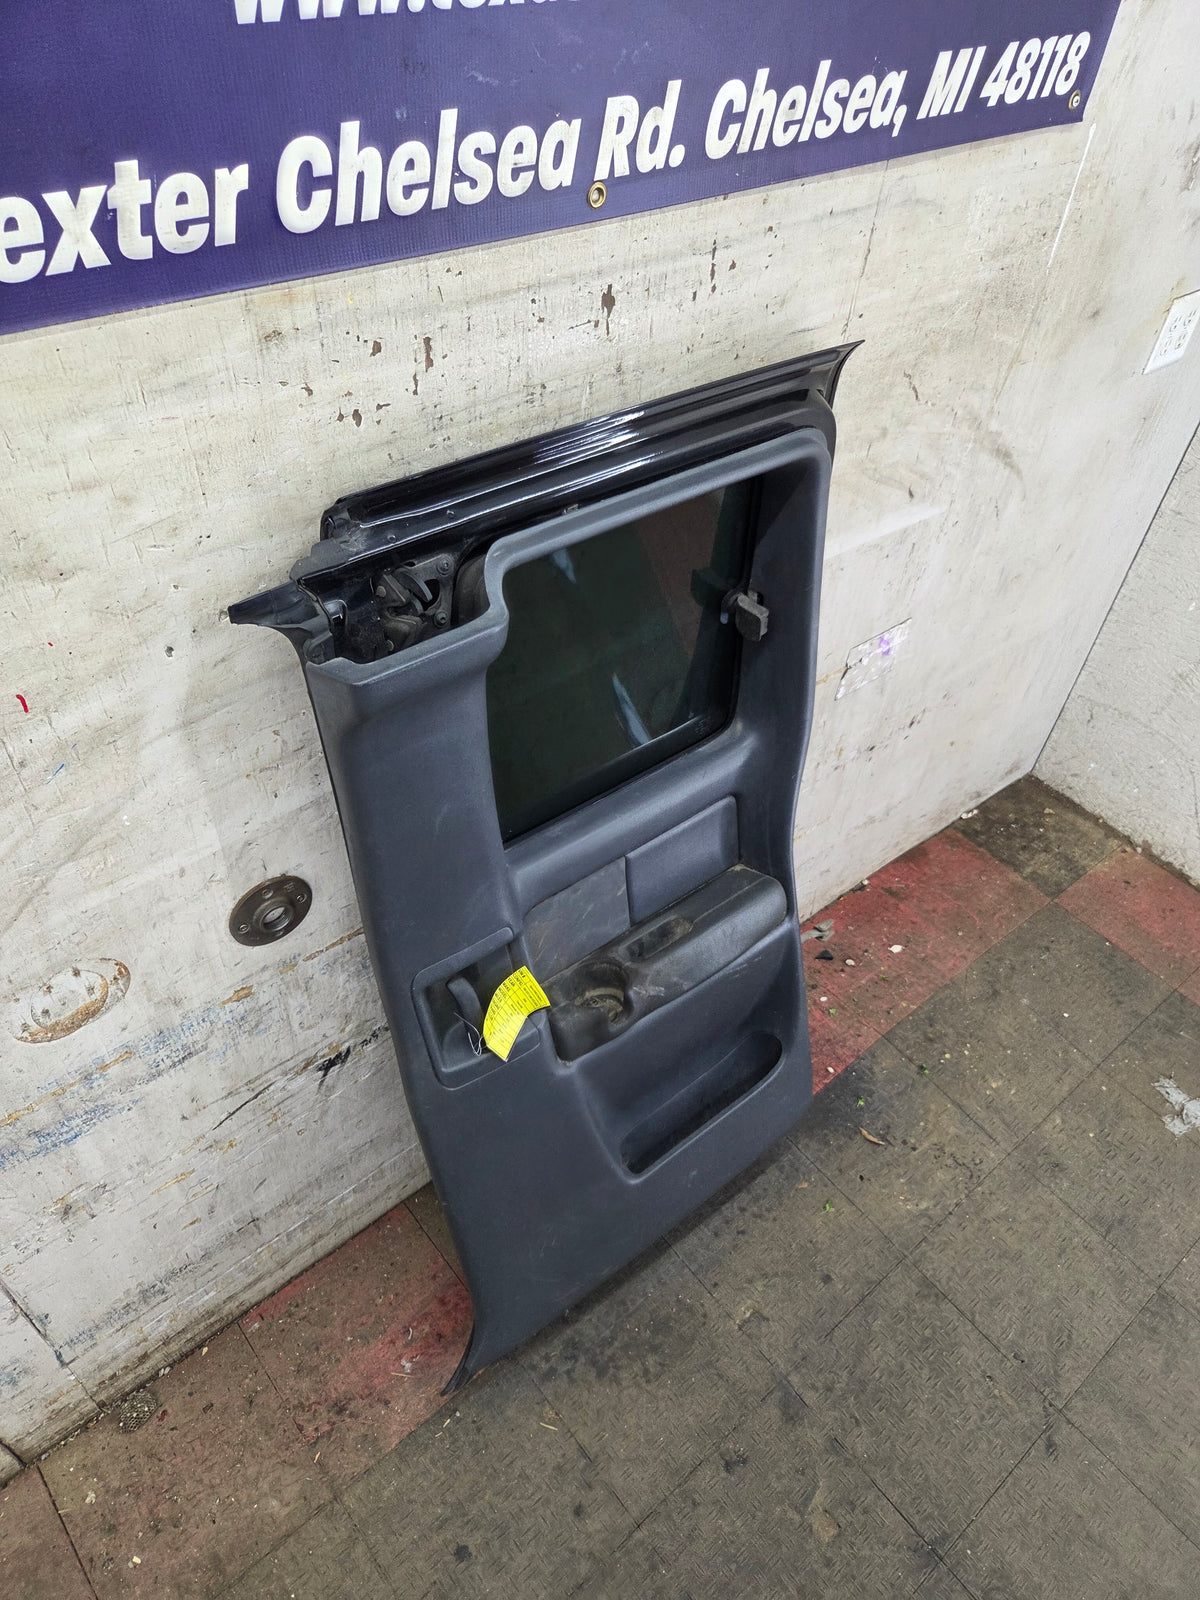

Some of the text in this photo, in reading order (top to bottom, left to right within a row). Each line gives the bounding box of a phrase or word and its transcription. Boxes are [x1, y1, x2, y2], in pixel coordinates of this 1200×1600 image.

[276, 107, 582, 234] Chelsea
[593, 79, 687, 182] Rd.
[704, 60, 908, 160] Chelsea,
[916, 46, 987, 120] MI
[979, 31, 1091, 108] 48118
